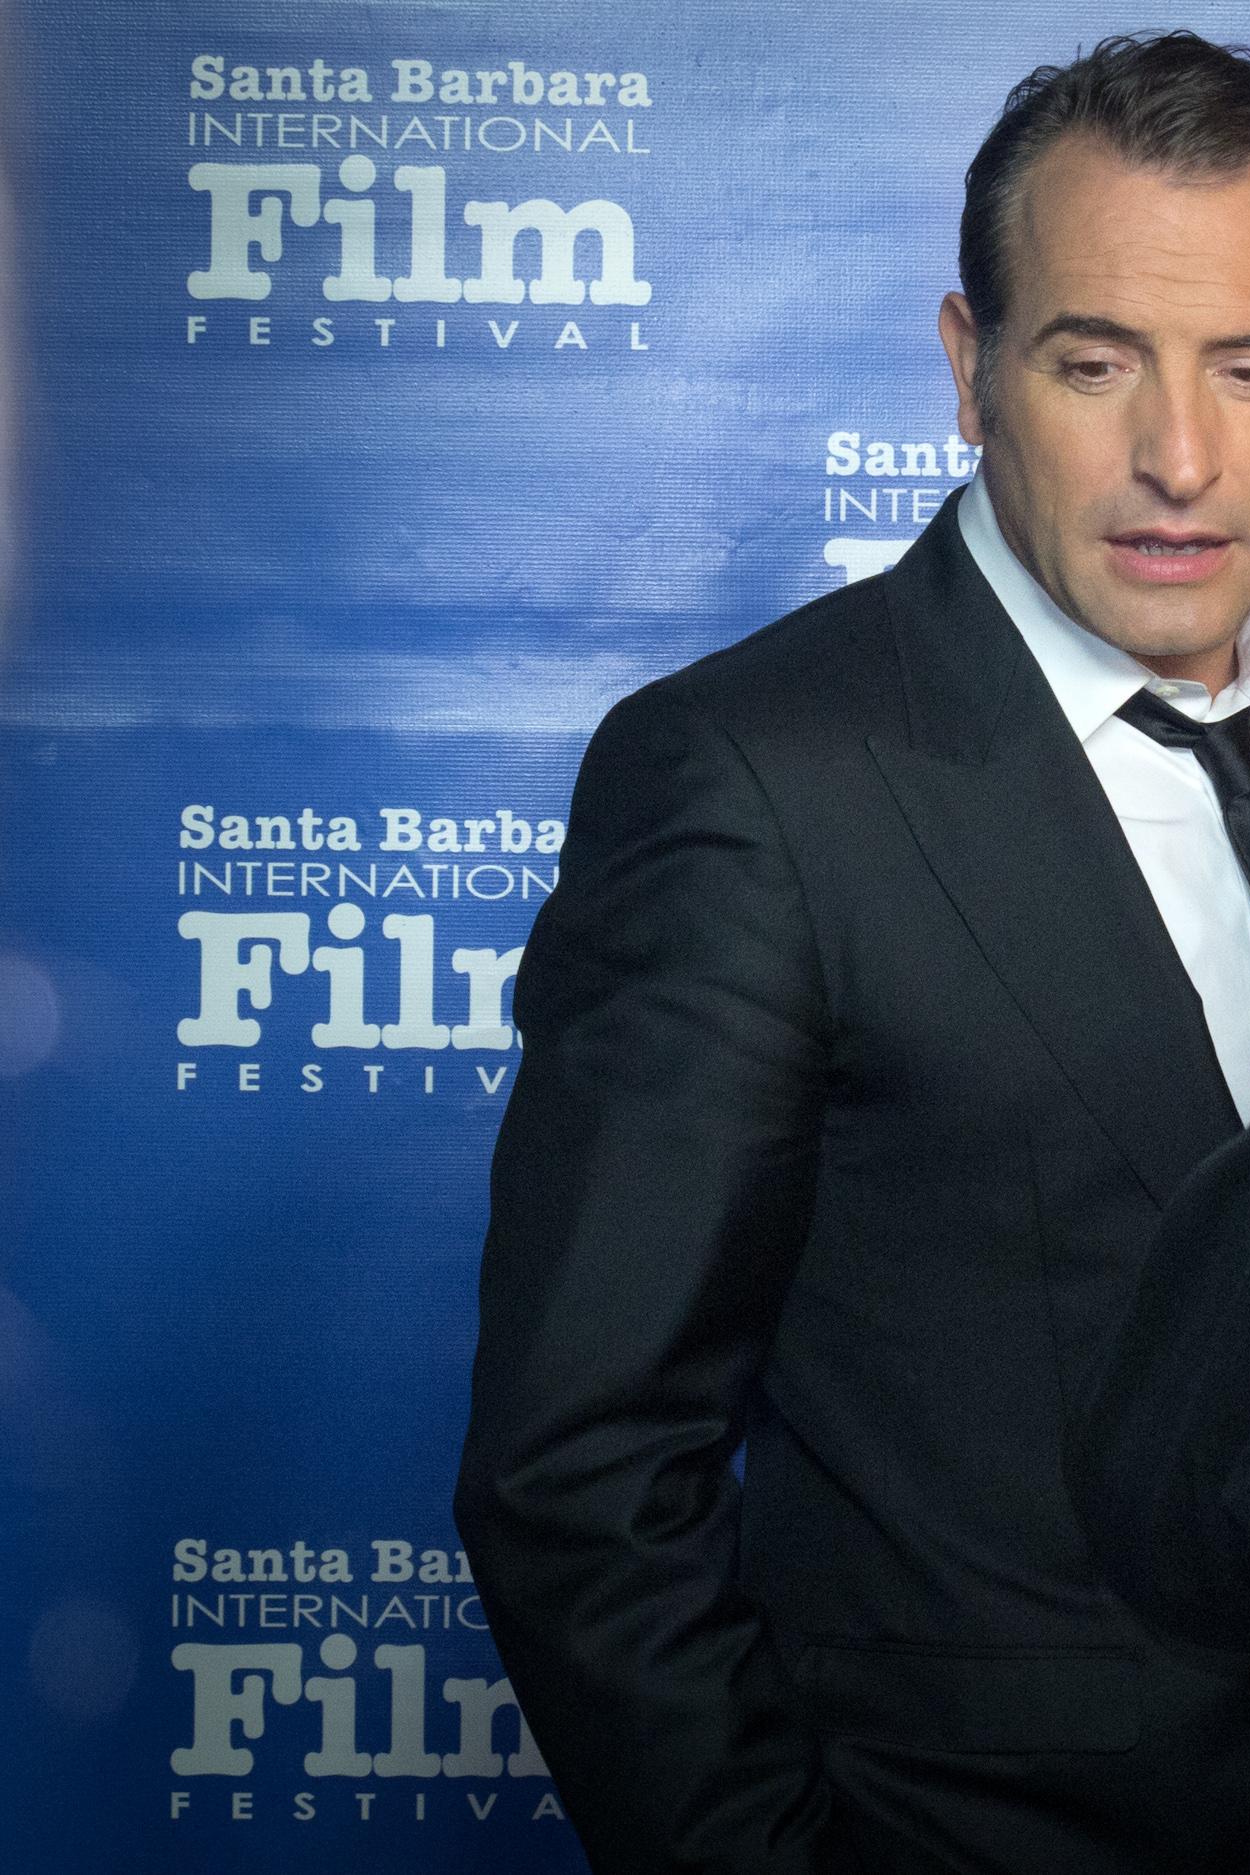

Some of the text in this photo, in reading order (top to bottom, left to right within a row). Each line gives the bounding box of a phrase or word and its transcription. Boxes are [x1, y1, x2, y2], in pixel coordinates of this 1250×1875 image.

[190, 55, 652, 107] Santa Barbara
[188, 112, 650, 154] INTERNATIONAL
[187, 154, 652, 306] Film
[187, 316, 649, 351] FESTIVAL
[826, 431, 983, 478] Sant
[179, 804, 361, 852] Santa
[172, 1538, 353, 1583] Santa
